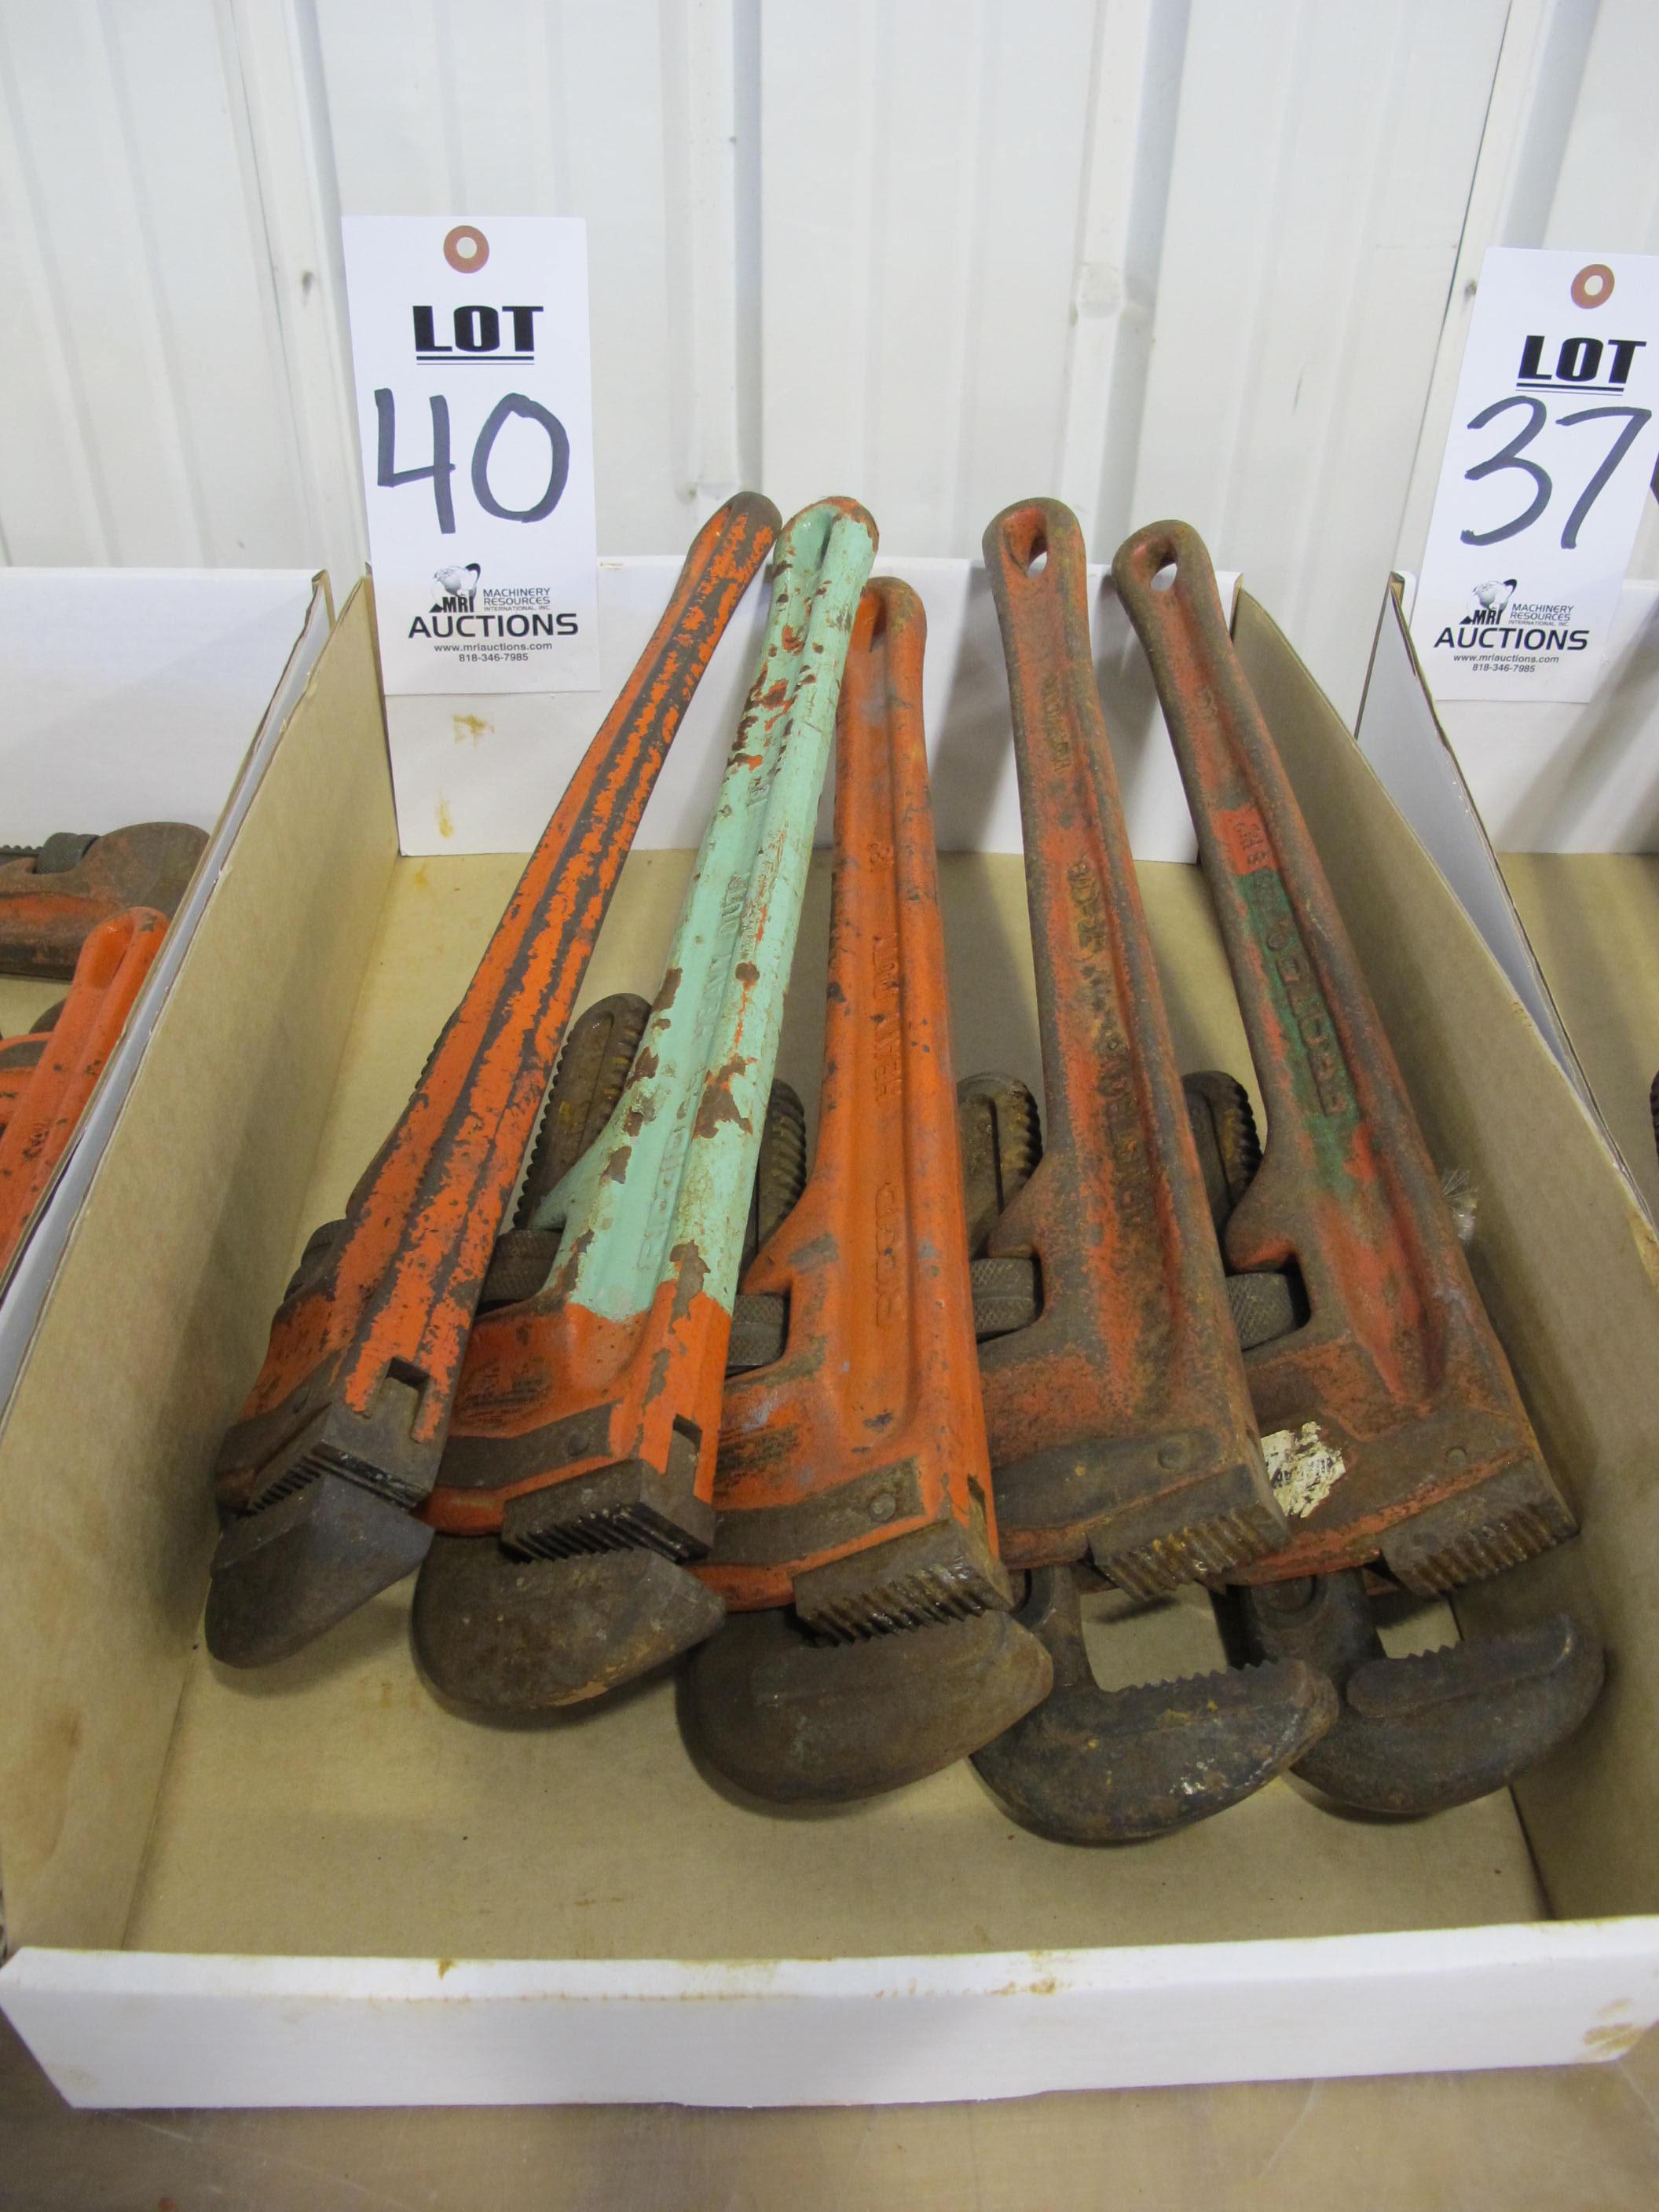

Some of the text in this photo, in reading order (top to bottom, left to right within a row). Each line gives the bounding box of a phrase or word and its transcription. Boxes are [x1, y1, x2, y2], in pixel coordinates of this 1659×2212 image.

[412, 306, 544, 353] LOT
[1517, 335, 1646, 385] LOT
[375, 388, 569, 534] 40
[1460, 396, 1651, 550] 37
[483, 588, 551, 598] MACHINERY
[442, 595, 475, 613] MRI
[483, 596, 551, 606] RESOURCES
[1511, 603, 1574, 613] MACHINERY
[1471, 610, 1503, 625] MRI
[1510, 612, 1571, 621] RESOURCES
[408, 613, 578, 638] AUCTIONS
[1434, 628, 1590, 650] AUCTIONS
[434, 643, 552, 652] www.mriauctions.com
[459, 653, 529, 662] 818-346-7985
[1453, 654, 1559, 664] www.mriauctions.com
[1472, 663, 1536, 672] 818-346-7985
